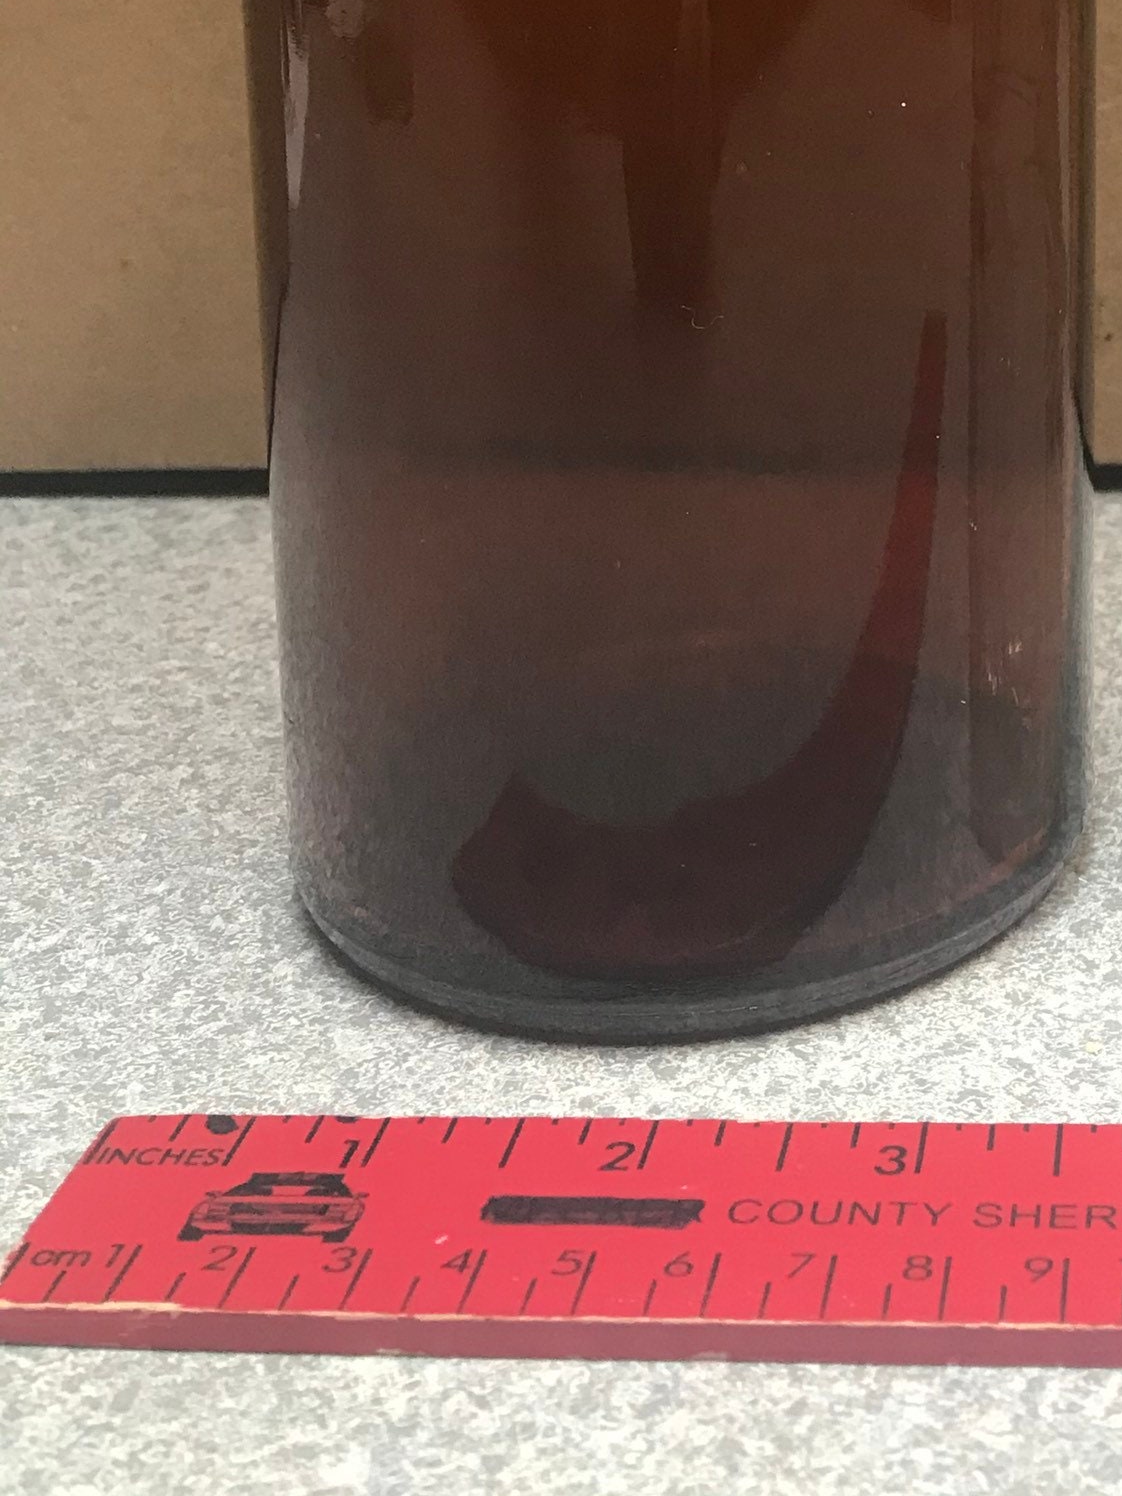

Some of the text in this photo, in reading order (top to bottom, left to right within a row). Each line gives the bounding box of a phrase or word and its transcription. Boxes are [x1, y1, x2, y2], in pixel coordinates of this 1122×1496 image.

[100, 1146, 225, 1167] INCHES
[338, 1139, 359, 1168] 1
[597, 1141, 636, 1173] 2
[873, 1145, 908, 1177] 3
[727, 1198, 954, 1227] COUNTY
[30, 1247, 91, 1267] cm
[106, 1243, 126, 1267] 1
[201, 1245, 237, 1272] 2
[321, 1246, 357, 1274] 3
[441, 1248, 473, 1273] 4
[551, 1249, 585, 1277] 5
[663, 1251, 695, 1278] 6
[785, 1253, 816, 1279] 7
[902, 1254, 934, 1281] 8
[1023, 1256, 1054, 1282] 9
